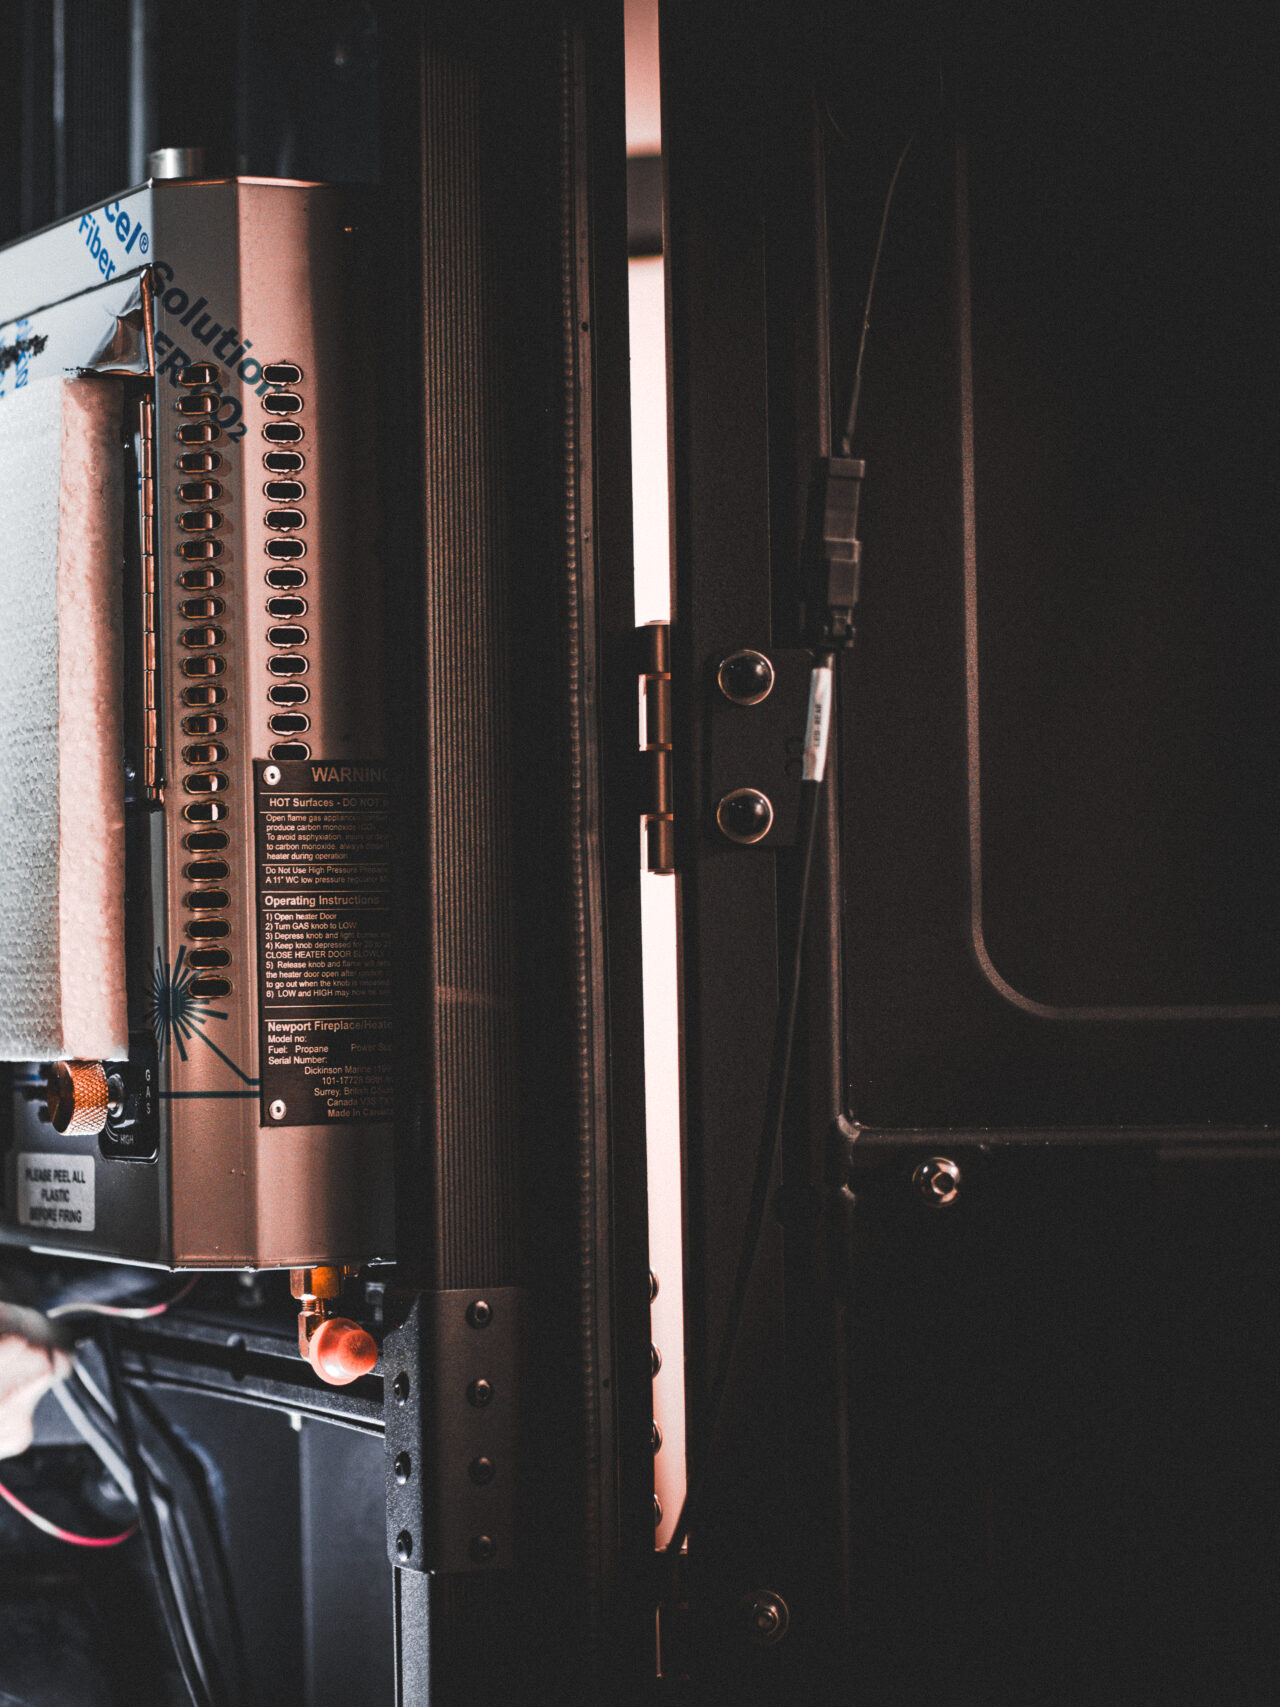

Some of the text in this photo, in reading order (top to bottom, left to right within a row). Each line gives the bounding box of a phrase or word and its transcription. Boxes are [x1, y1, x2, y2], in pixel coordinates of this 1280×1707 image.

[78, 213, 116, 281] Fiber
[269, 798, 290, 807] HOT
[293, 797, 334, 807] Surfaces
[342, 798, 357, 807] DO
[266, 814, 286, 822] Open
[287, 814, 307, 822] flame
[308, 815, 322, 823] gas
[266, 823, 295, 832] produce
[296, 823, 320, 831] carbon
[266, 833, 275, 841] To
[276, 833, 296, 841] avoid
[275, 842, 300, 850] carbon
[266, 852, 290, 860] heater
[291, 852, 314, 862] during
[265, 866, 276, 874] Do
[278, 866, 291, 874] Not
[292, 866, 307, 874] Use
[308, 866, 325, 875] High
[326, 866, 358, 874] Pressure
[264, 894, 380, 908] Operating Instructions
[265, 912, 337, 921] 1) Open heater Door
[265, 922, 273, 931] 2)
[274, 922, 291, 930] Turn
[292, 922, 309, 930] GAS
[310, 922, 328, 930] knob
[330, 922, 337, 930] to
[265, 932, 273, 941] 3)
[274, 932, 304, 941] Depress
[306, 932, 323, 940] knob
[265, 942, 273, 950] 4)
[274, 942, 294, 950] Keep
[314, 941, 351, 950] depressed
[266, 951, 293, 959] CLOSE
[294, 951, 326, 959] HEATER
[328, 950, 351, 958] DOOR
[266, 961, 274, 969] 5)
[277, 961, 306, 969] Release
[308, 960, 326, 968] knob
[327, 960, 341, 968] and
[266, 971, 278, 979] the
[279, 971, 302, 979] heater
[303, 970, 320, 978] door
[321, 971, 340, 979] open
[266, 980, 274, 988] to
[275, 982, 285, 990] go
[286, 980, 298, 988] out
[320, 979, 331, 987] the
[333, 979, 351, 987] knob
[266, 990, 274, 999] 6)
[278, 990, 297, 998] LOW
[298, 989, 312, 997] and
[313, 989, 333, 997] HIGH
[267, 1021, 312, 1033] Newport
[268, 1035, 307, 1043] Model no:
[268, 1045, 288, 1054] Fuel:
[295, 1045, 329, 1054] Propane
[268, 1056, 328, 1065] Serial Number:
[304, 1066, 343, 1076] Dickinson
[327, 1109, 351, 1118] Made
[25, 1168, 86, 1184] PLEASE PEEL ALL
[41, 1188, 70, 1203] PLASTIC
[29, 1206, 82, 1224] BEFORE FIRING
